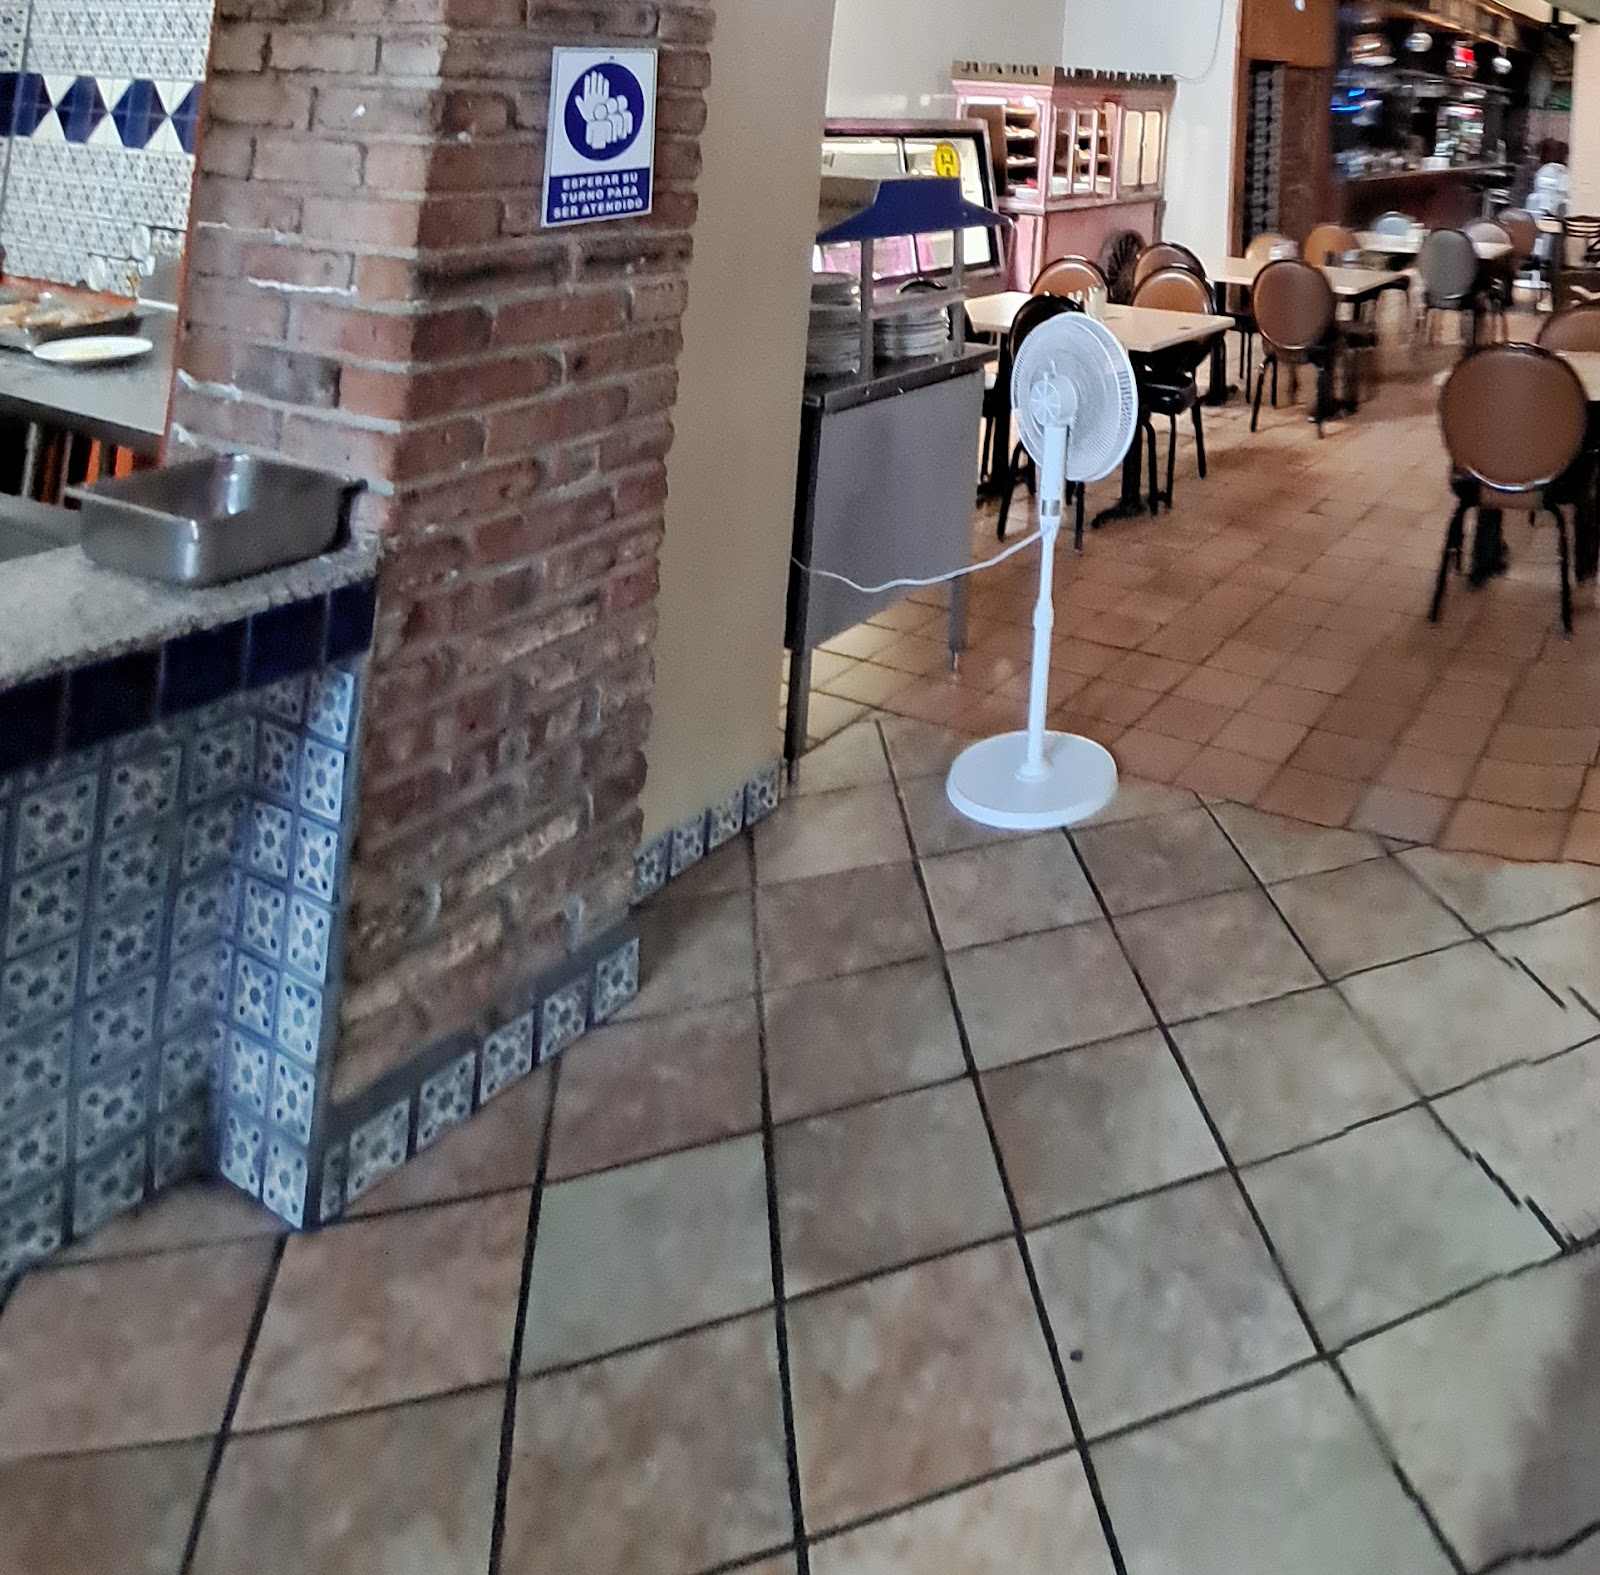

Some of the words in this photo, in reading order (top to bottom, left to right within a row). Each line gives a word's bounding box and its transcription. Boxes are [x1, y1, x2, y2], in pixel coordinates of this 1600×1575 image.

[562, 174, 619, 191] ESPERAR
[622, 172, 638, 184] SU
[561, 189, 604, 204] TURNO
[607, 185, 638, 199] PARA
[553, 205, 578, 219] SER
[581, 197, 643, 215] ATENDIDO
